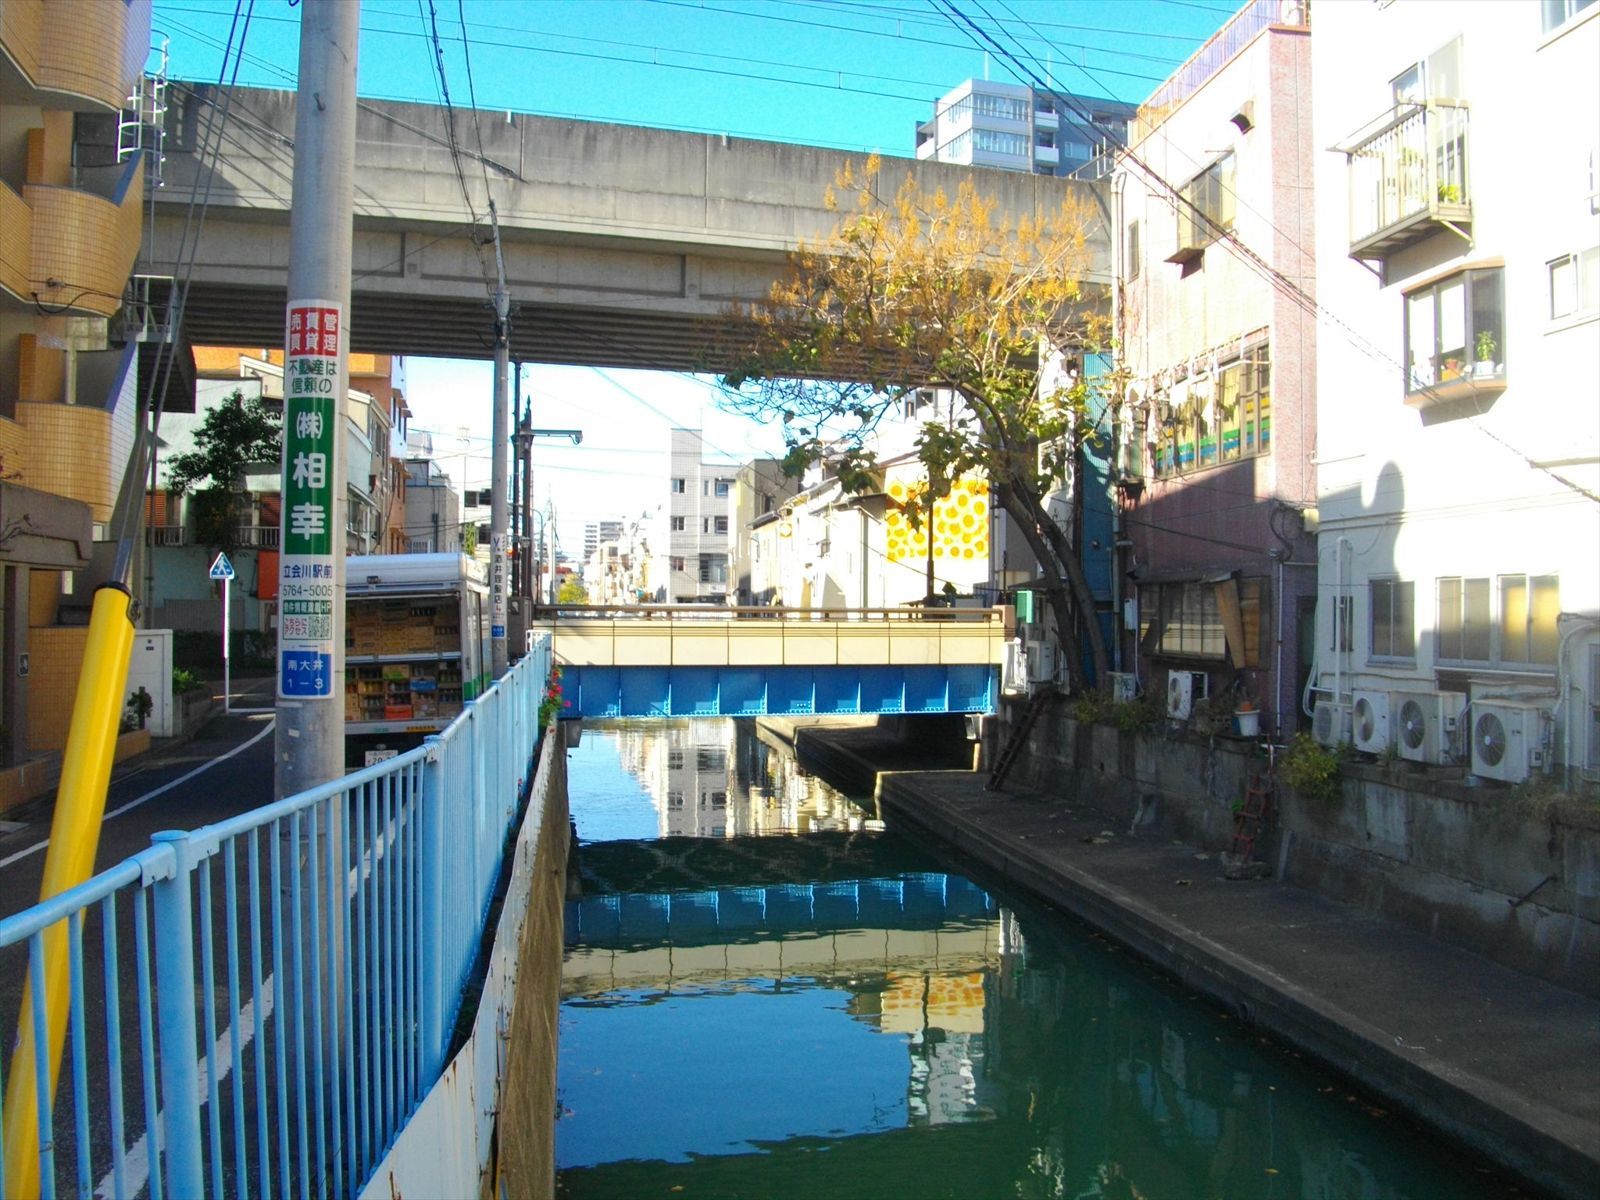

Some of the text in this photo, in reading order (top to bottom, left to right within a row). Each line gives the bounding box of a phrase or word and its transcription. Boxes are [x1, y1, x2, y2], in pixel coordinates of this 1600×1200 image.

[305, 312, 319, 351] 賃貸
[324, 313, 337, 352] 管理
[288, 358, 337, 376] 不動産は
[292, 377, 332, 394] 信頼の
[283, 564, 333, 579] 立会川駅前
[283, 585, 333, 598] 5764-5005
[287, 660, 324, 671] 南大井
